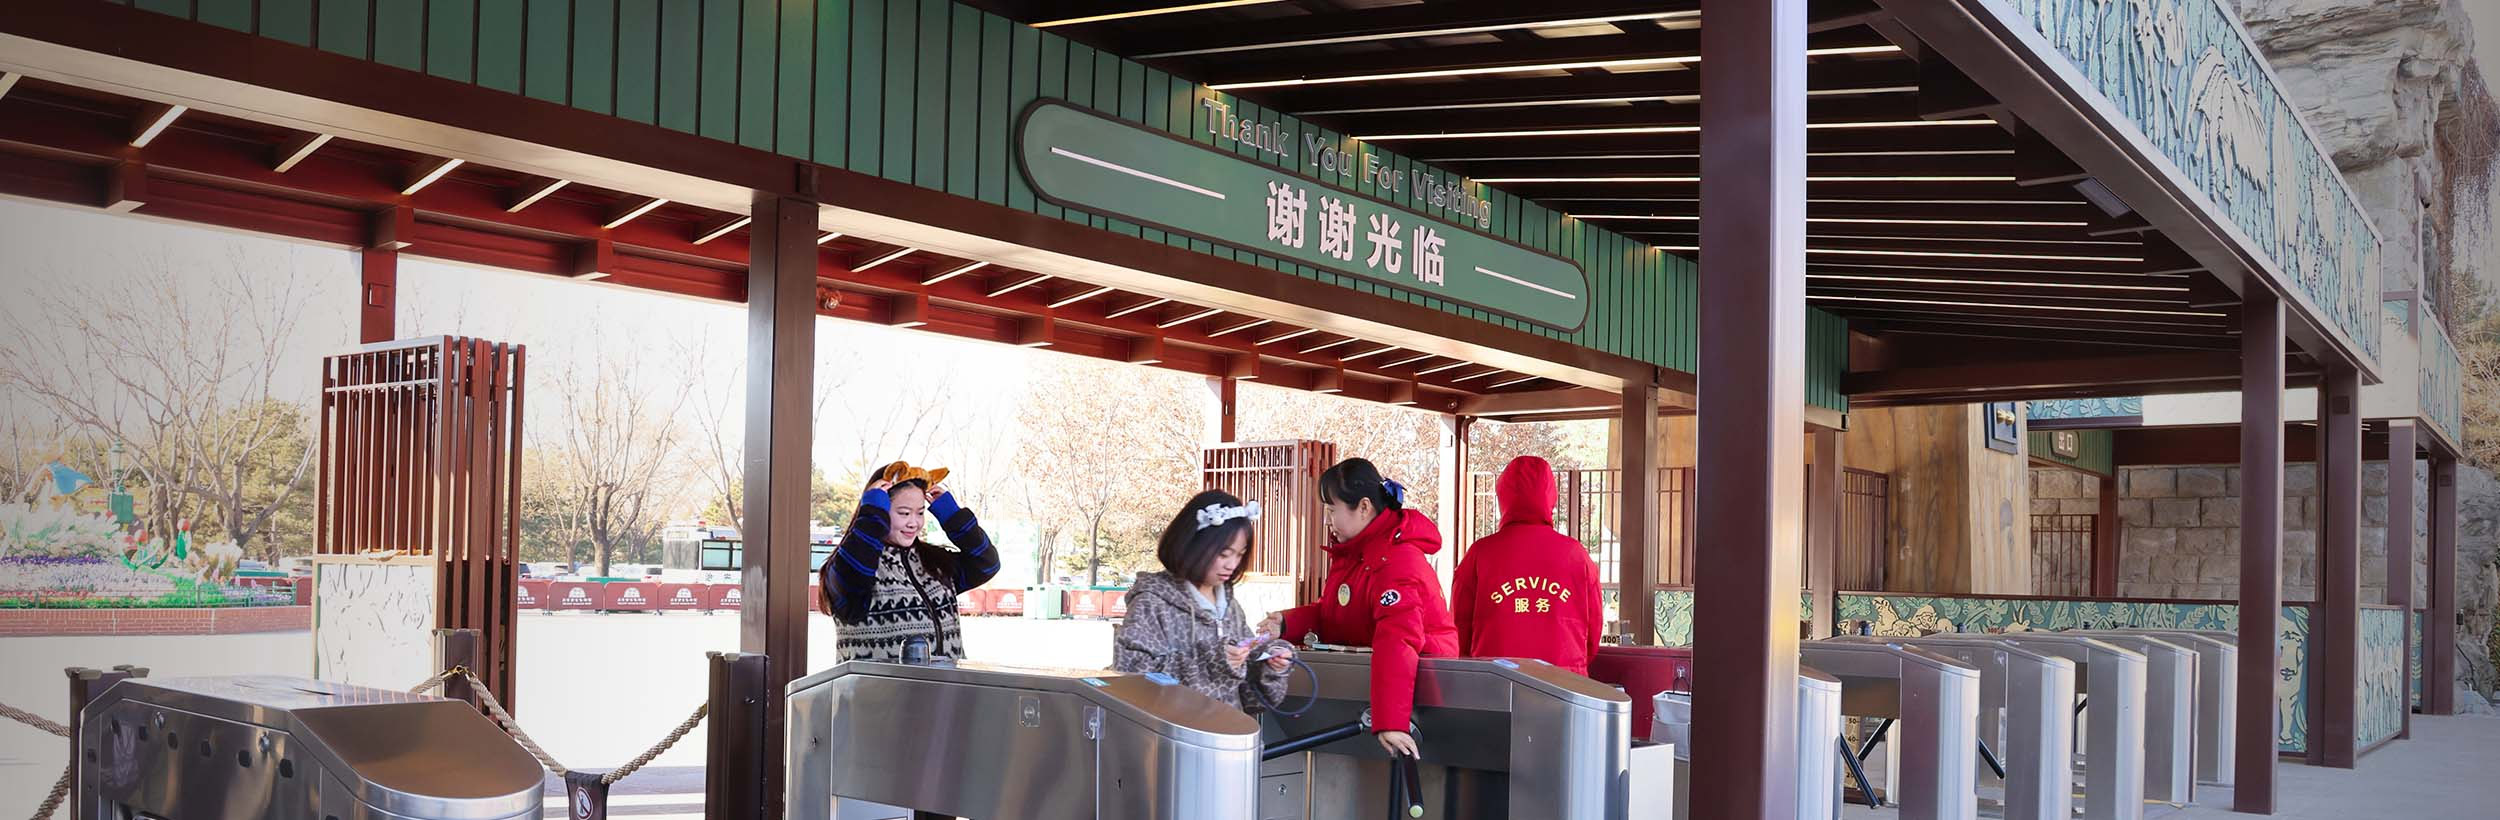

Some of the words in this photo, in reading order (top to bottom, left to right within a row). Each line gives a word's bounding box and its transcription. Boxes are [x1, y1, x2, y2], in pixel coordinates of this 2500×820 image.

[1202, 97, 1289, 158] Thank
[1305, 133, 1352, 177] You
[1364, 152, 1403, 193] For
[1412, 169, 1492, 229] Visiting
[1266, 180, 1446, 287] 谢谢光临
[1490, 576, 1572, 604] SERVICE
[1514, 597, 1551, 613] 服务
